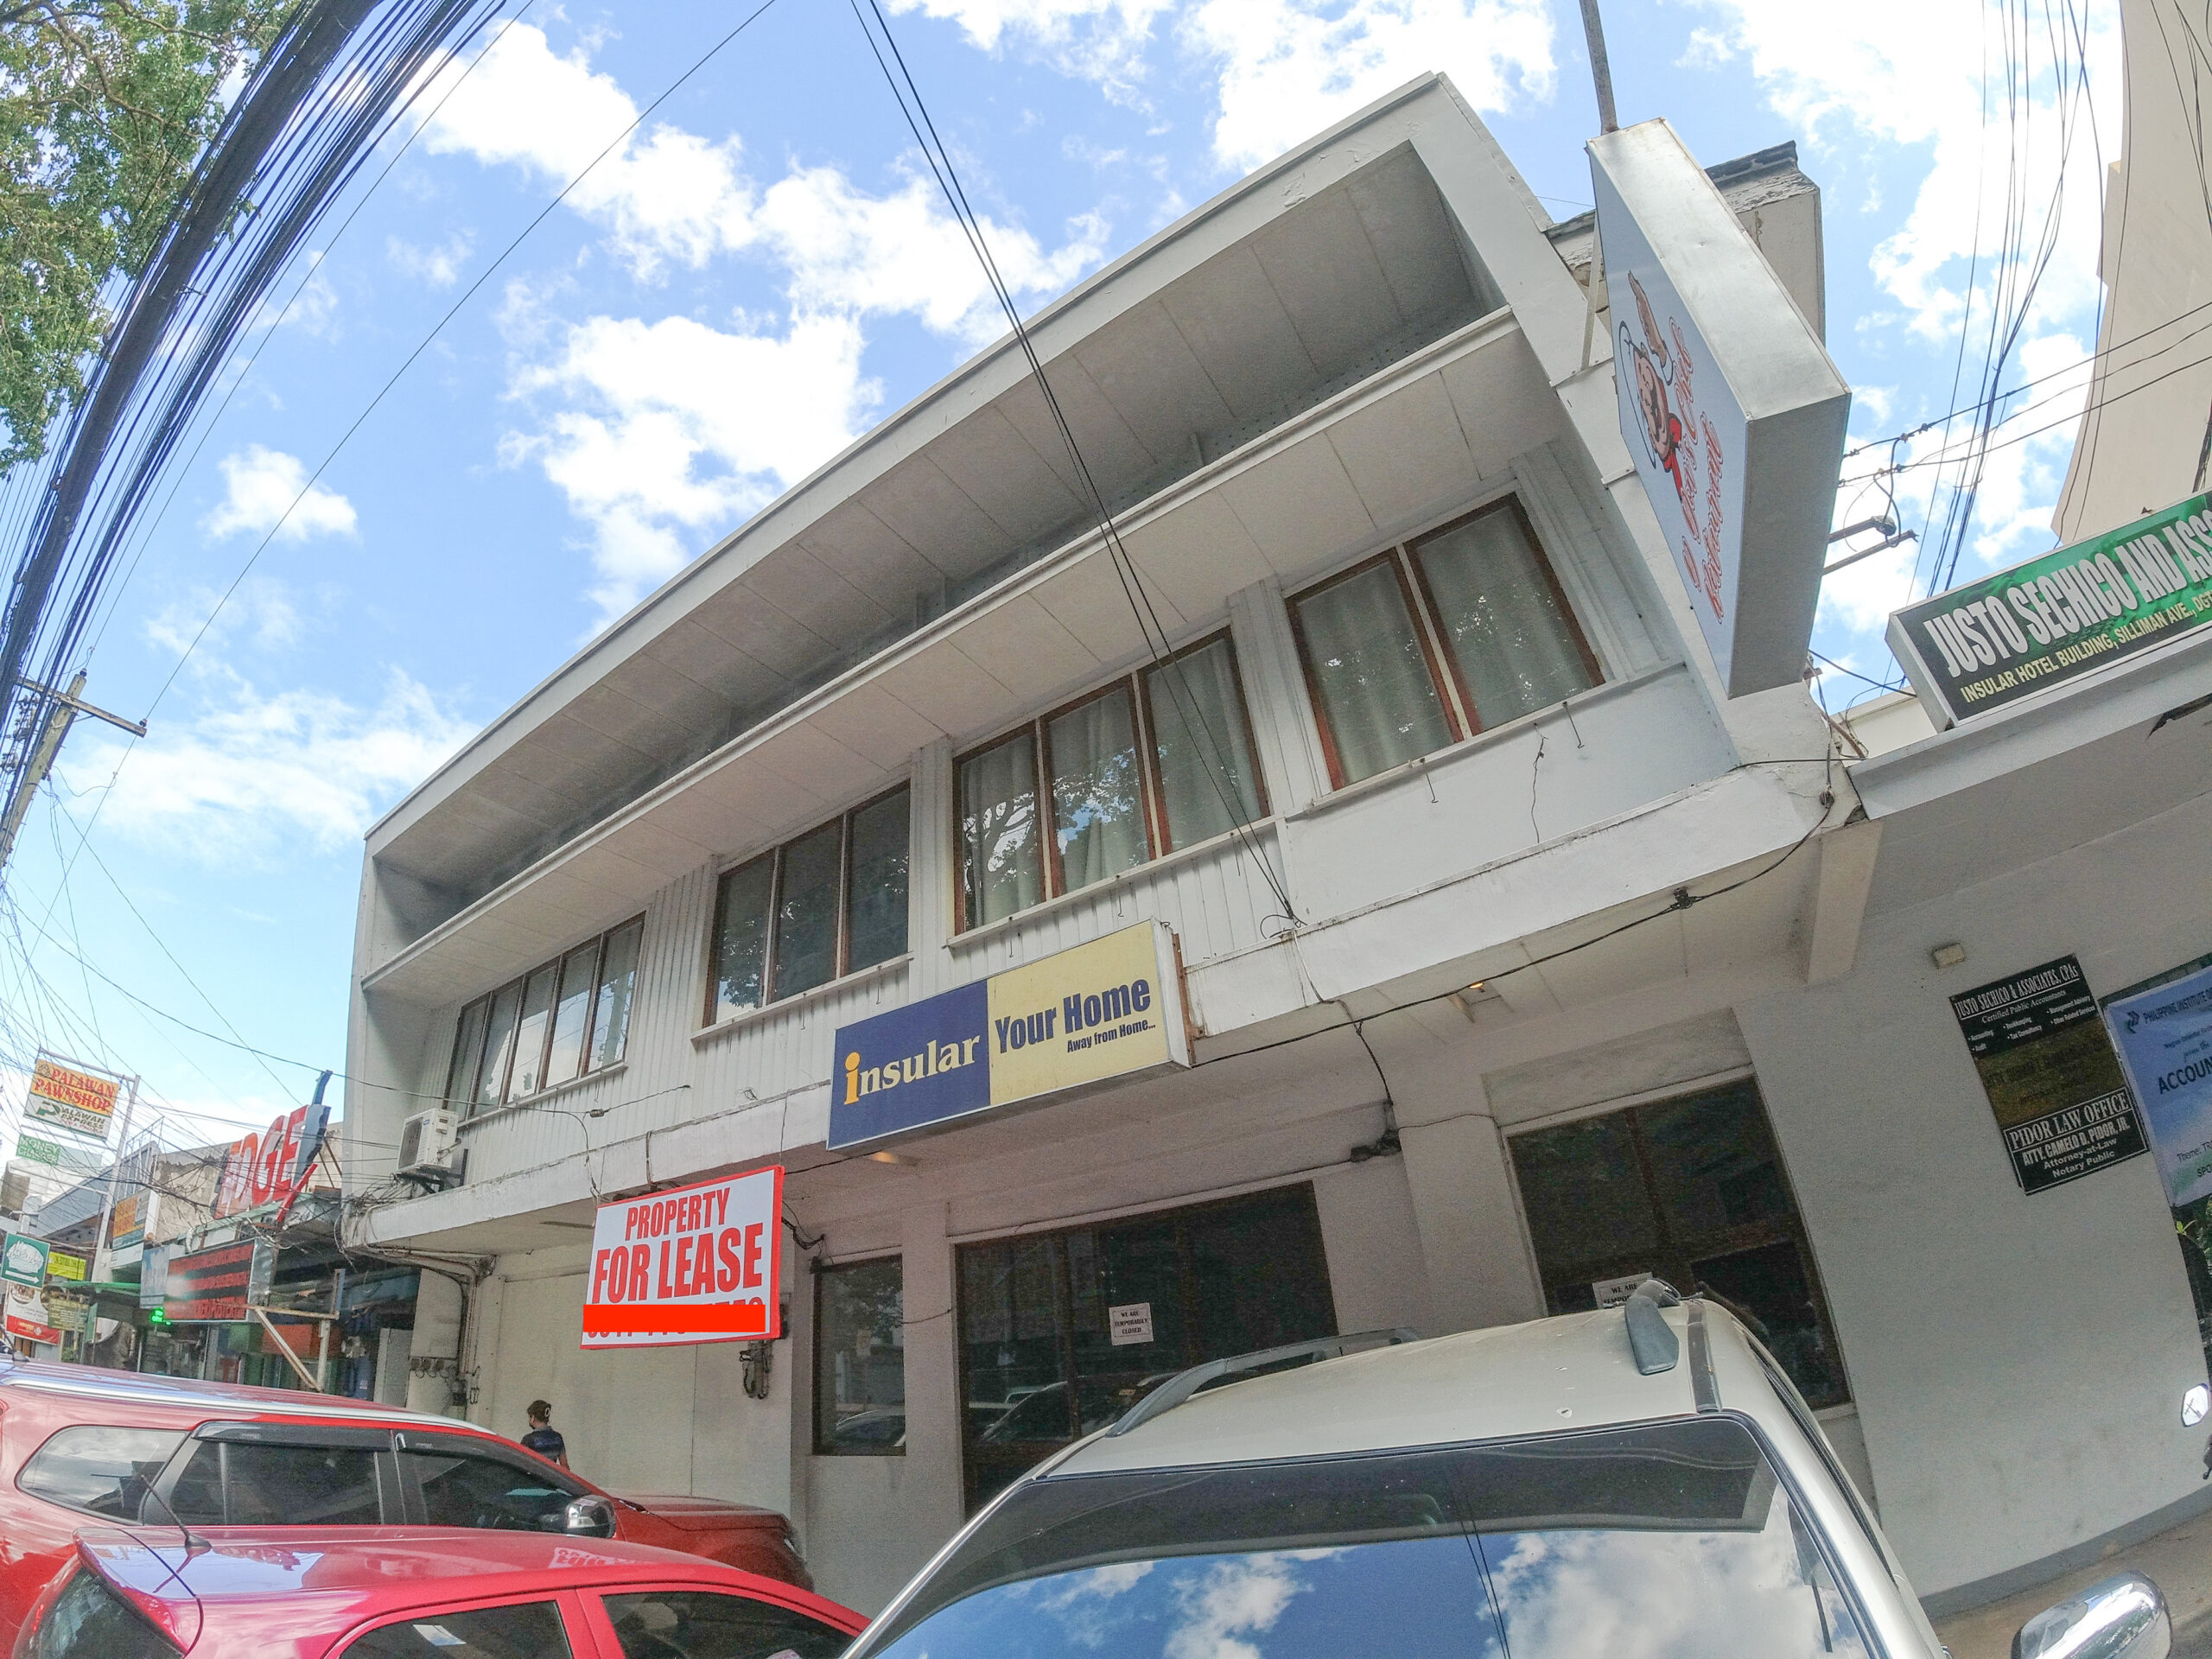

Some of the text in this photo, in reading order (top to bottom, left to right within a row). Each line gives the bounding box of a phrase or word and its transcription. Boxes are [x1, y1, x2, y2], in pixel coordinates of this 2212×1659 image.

[1923, 510, 2212, 677] JUSTO SECHICO AND ASS
[1961, 671, 2019, 702] INSULAR
[2017, 656, 2059, 683] HOTEL
[2056, 632, 2118, 668] BUILDING,
[2114, 612, 2168, 645] SILLIMAN
[1955, 963, 2079, 1018] JUSTO SECHICO & ASSOCIATES, CPAs
[1981, 989, 2066, 1024] Certified Public Accountants
[2143, 1002, 2178, 1024] PHILIPPINE
[2177, 992, 2204, 1011] INSTITUTE
[844, 979, 1150, 1105] insular Your Home
[1067, 1034, 1092, 1053] Away
[1093, 1027, 1117, 1045] from
[35, 1078, 111, 1111] PAWNSHOP
[52, 1069, 114, 1097] PALAWAN
[61, 1114, 104, 1130] EXPRESS
[2010, 1092, 2129, 1149] PIDOR LAW OFFICE
[20, 1136, 60, 1154] MONEY
[2022, 1147, 2046, 1166] ATTY.
[2045, 1134, 2081, 1158] CAMELO
[2080, 1132, 2089, 1146] D.
[2117, 1116, 2131, 1131] JR.
[2044, 1138, 2117, 1169] Attorney-at-Law
[2177, 1147, 2202, 1162] Theme:
[2052, 1151, 2115, 1178] Notary Public
[625, 1187, 730, 1241] PROPERTY
[592, 1223, 763, 1304] FOR LEASE
